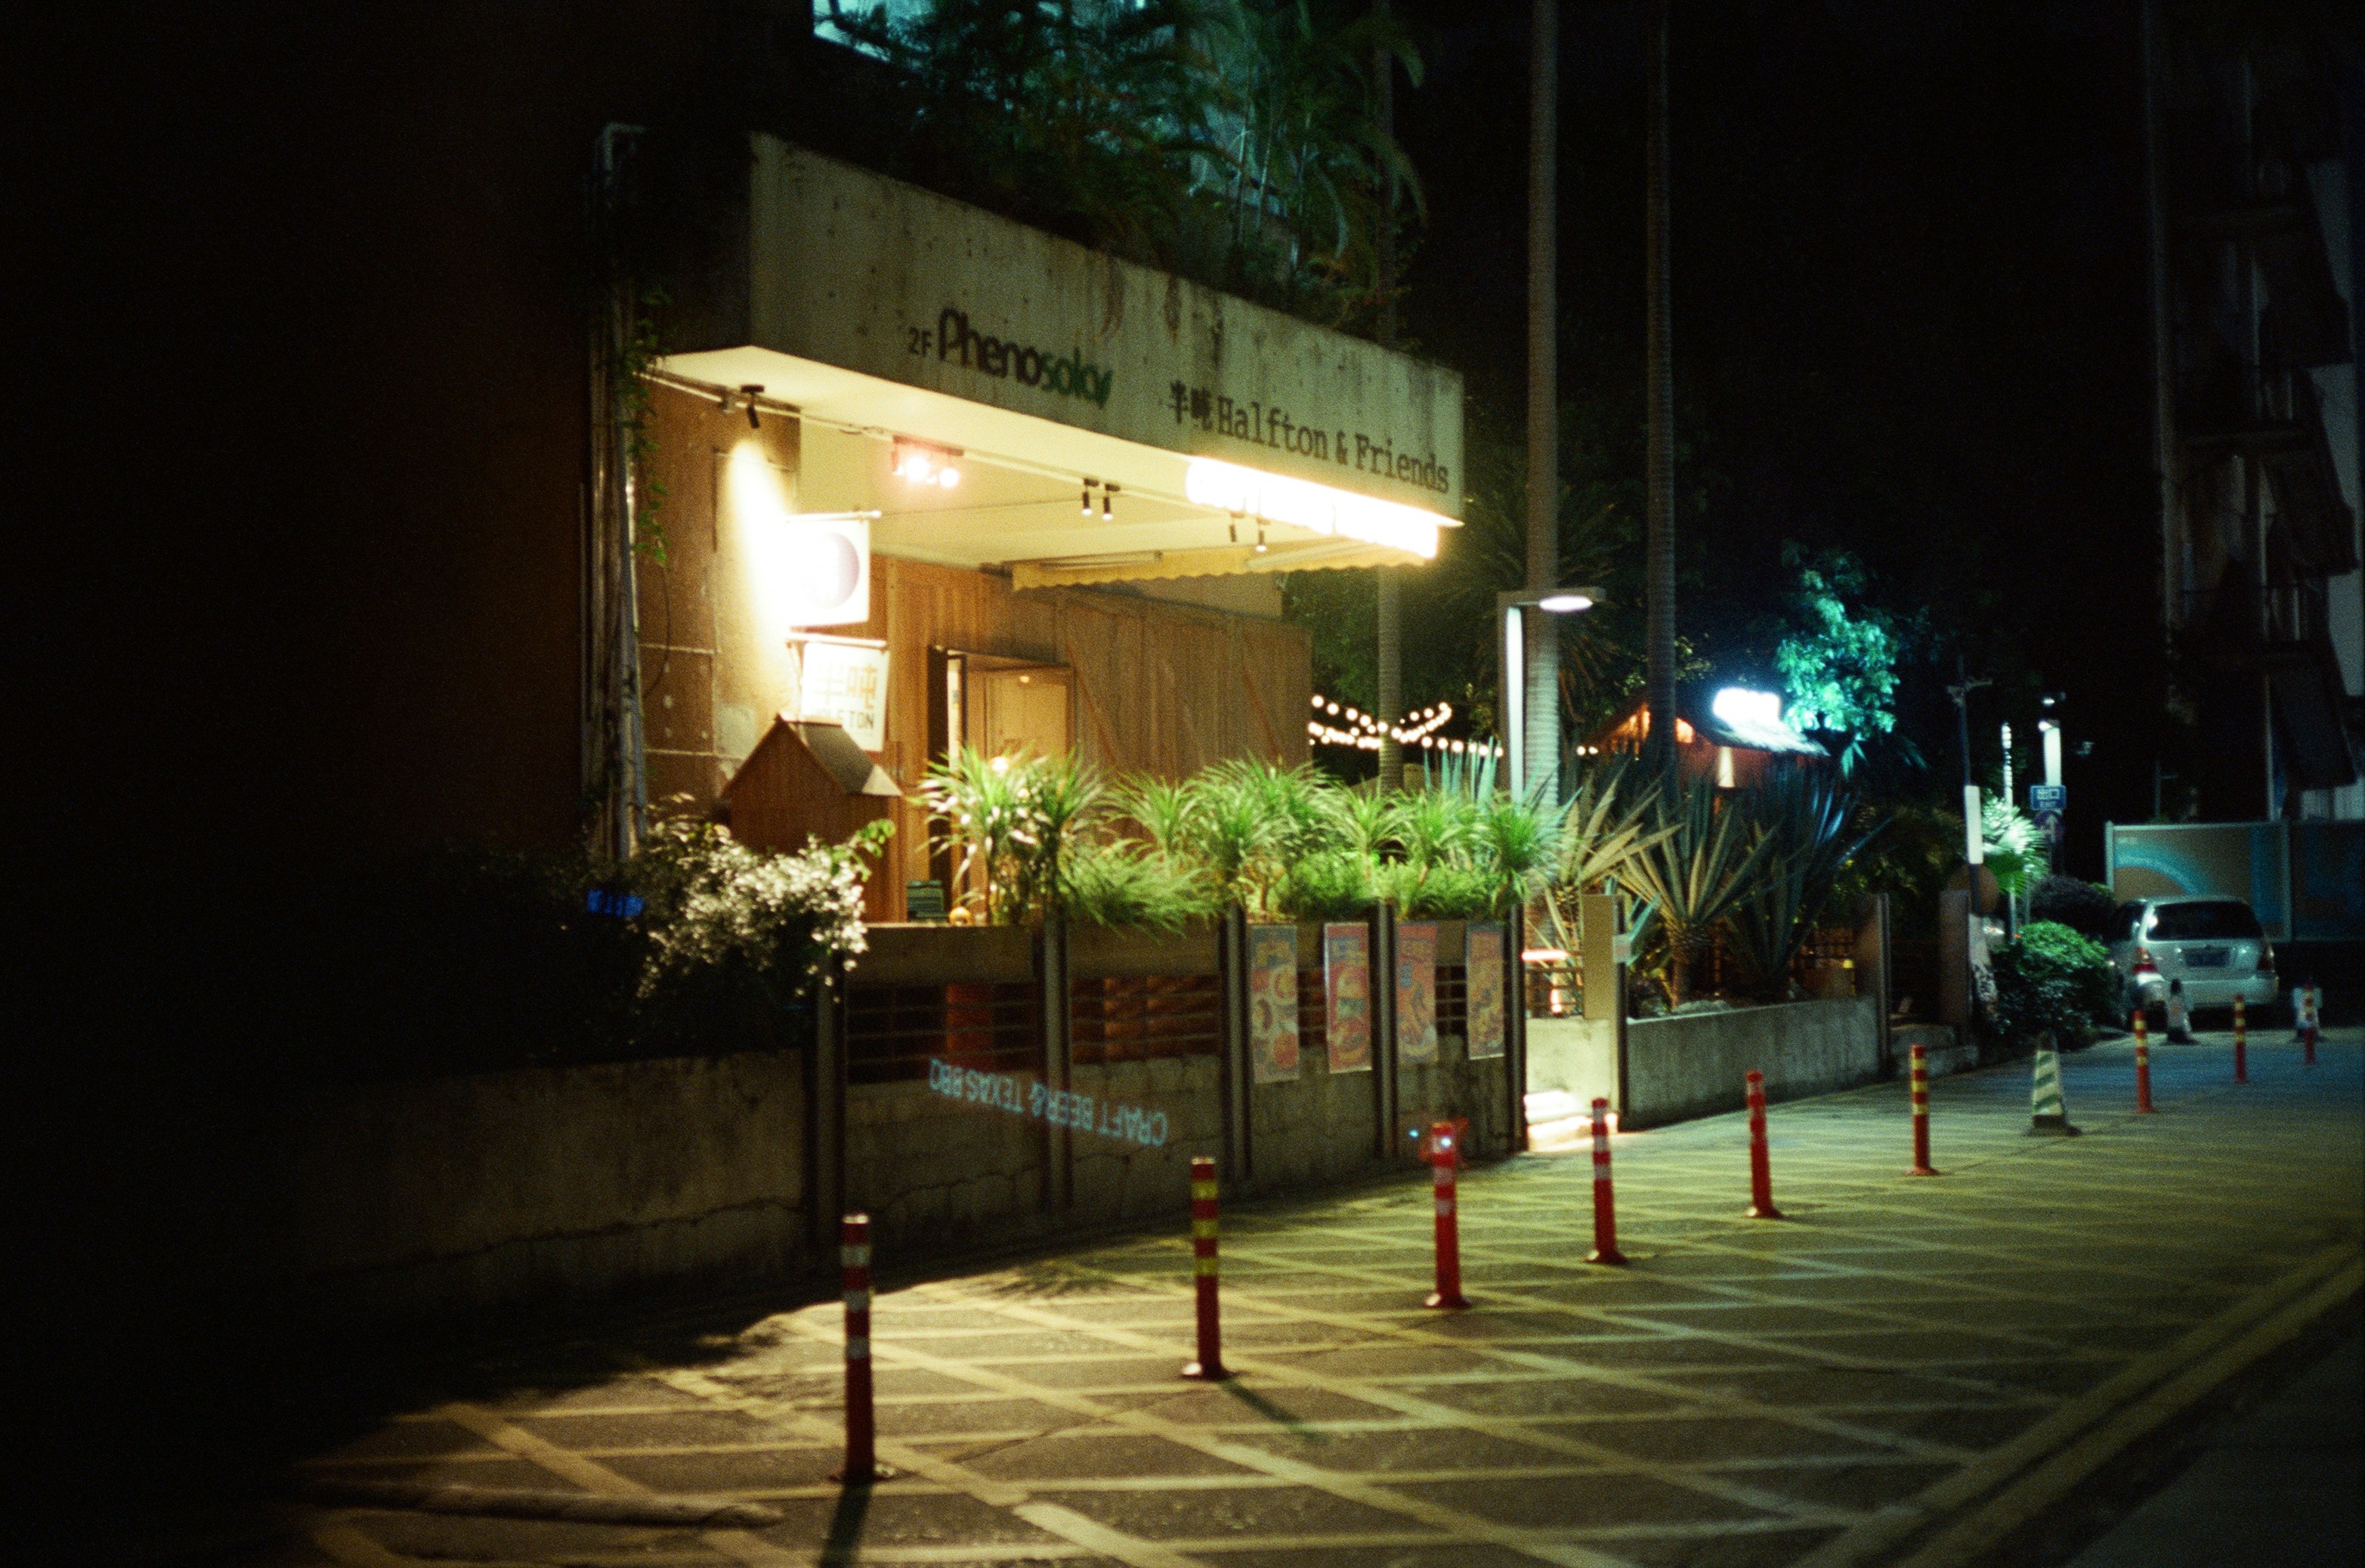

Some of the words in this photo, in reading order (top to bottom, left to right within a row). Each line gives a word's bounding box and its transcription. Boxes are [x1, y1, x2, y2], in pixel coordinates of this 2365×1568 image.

[907, 326, 932, 357] 2F
[1217, 395, 1328, 460] Halfton
[1335, 430, 1349, 465] &
[1355, 432, 1449, 493] Friends
[929, 1058, 963, 1098] BBQ
[965, 1068, 1024, 1114] TEXAS
[1099, 1100, 1168, 1147] CRAFT
